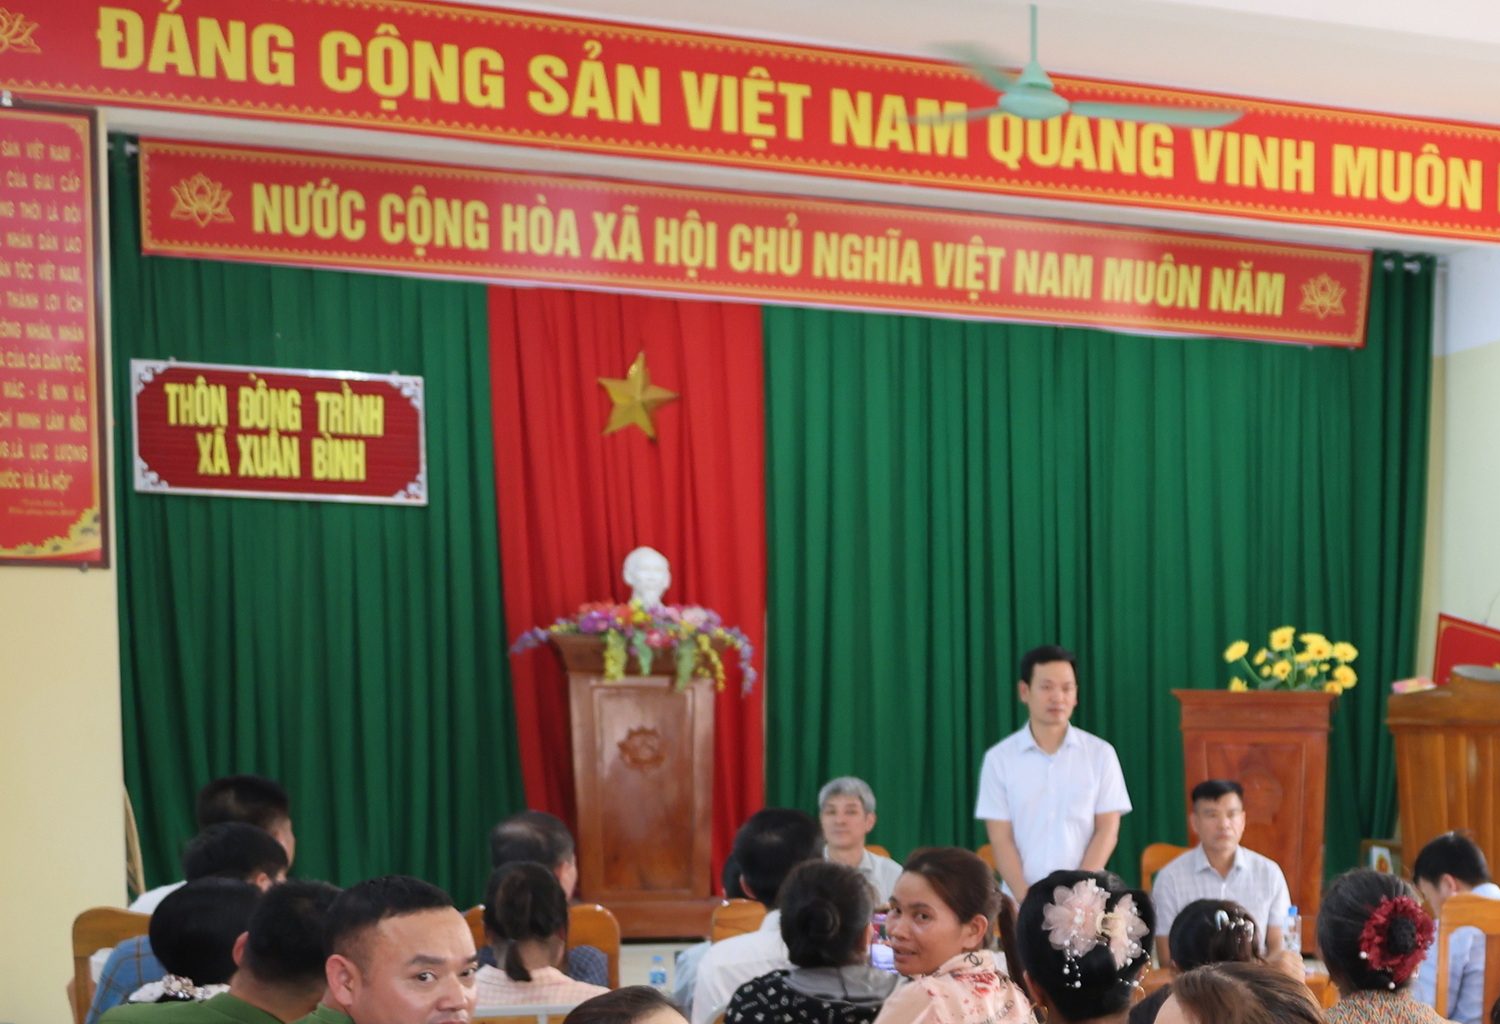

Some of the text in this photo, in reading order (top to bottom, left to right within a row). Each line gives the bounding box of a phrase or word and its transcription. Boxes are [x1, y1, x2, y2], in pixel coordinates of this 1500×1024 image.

[97, 1, 294, 86] ĐẢNG
[321, 24, 504, 110] CỘNG
[528, 42, 660, 125] SẢN
[681, 67, 811, 151] VIỆT
[831, 88, 968, 157] NAM
[988, 110, 1175, 178] QUANG
[1191, 128, 1316, 193] VINH
[1332, 142, 1482, 211] MUÔN
[252, 181, 1284, 316] NƯỚC CỘNG HÒA XÃ HỘI CHỦ NGHĨA VIỆT NAM MUÔN NĂM
[164, 372, 385, 437] THÔN ĐỒNG TRÌNH
[196, 426, 367, 481] XÃ XUÂN BÌNH
